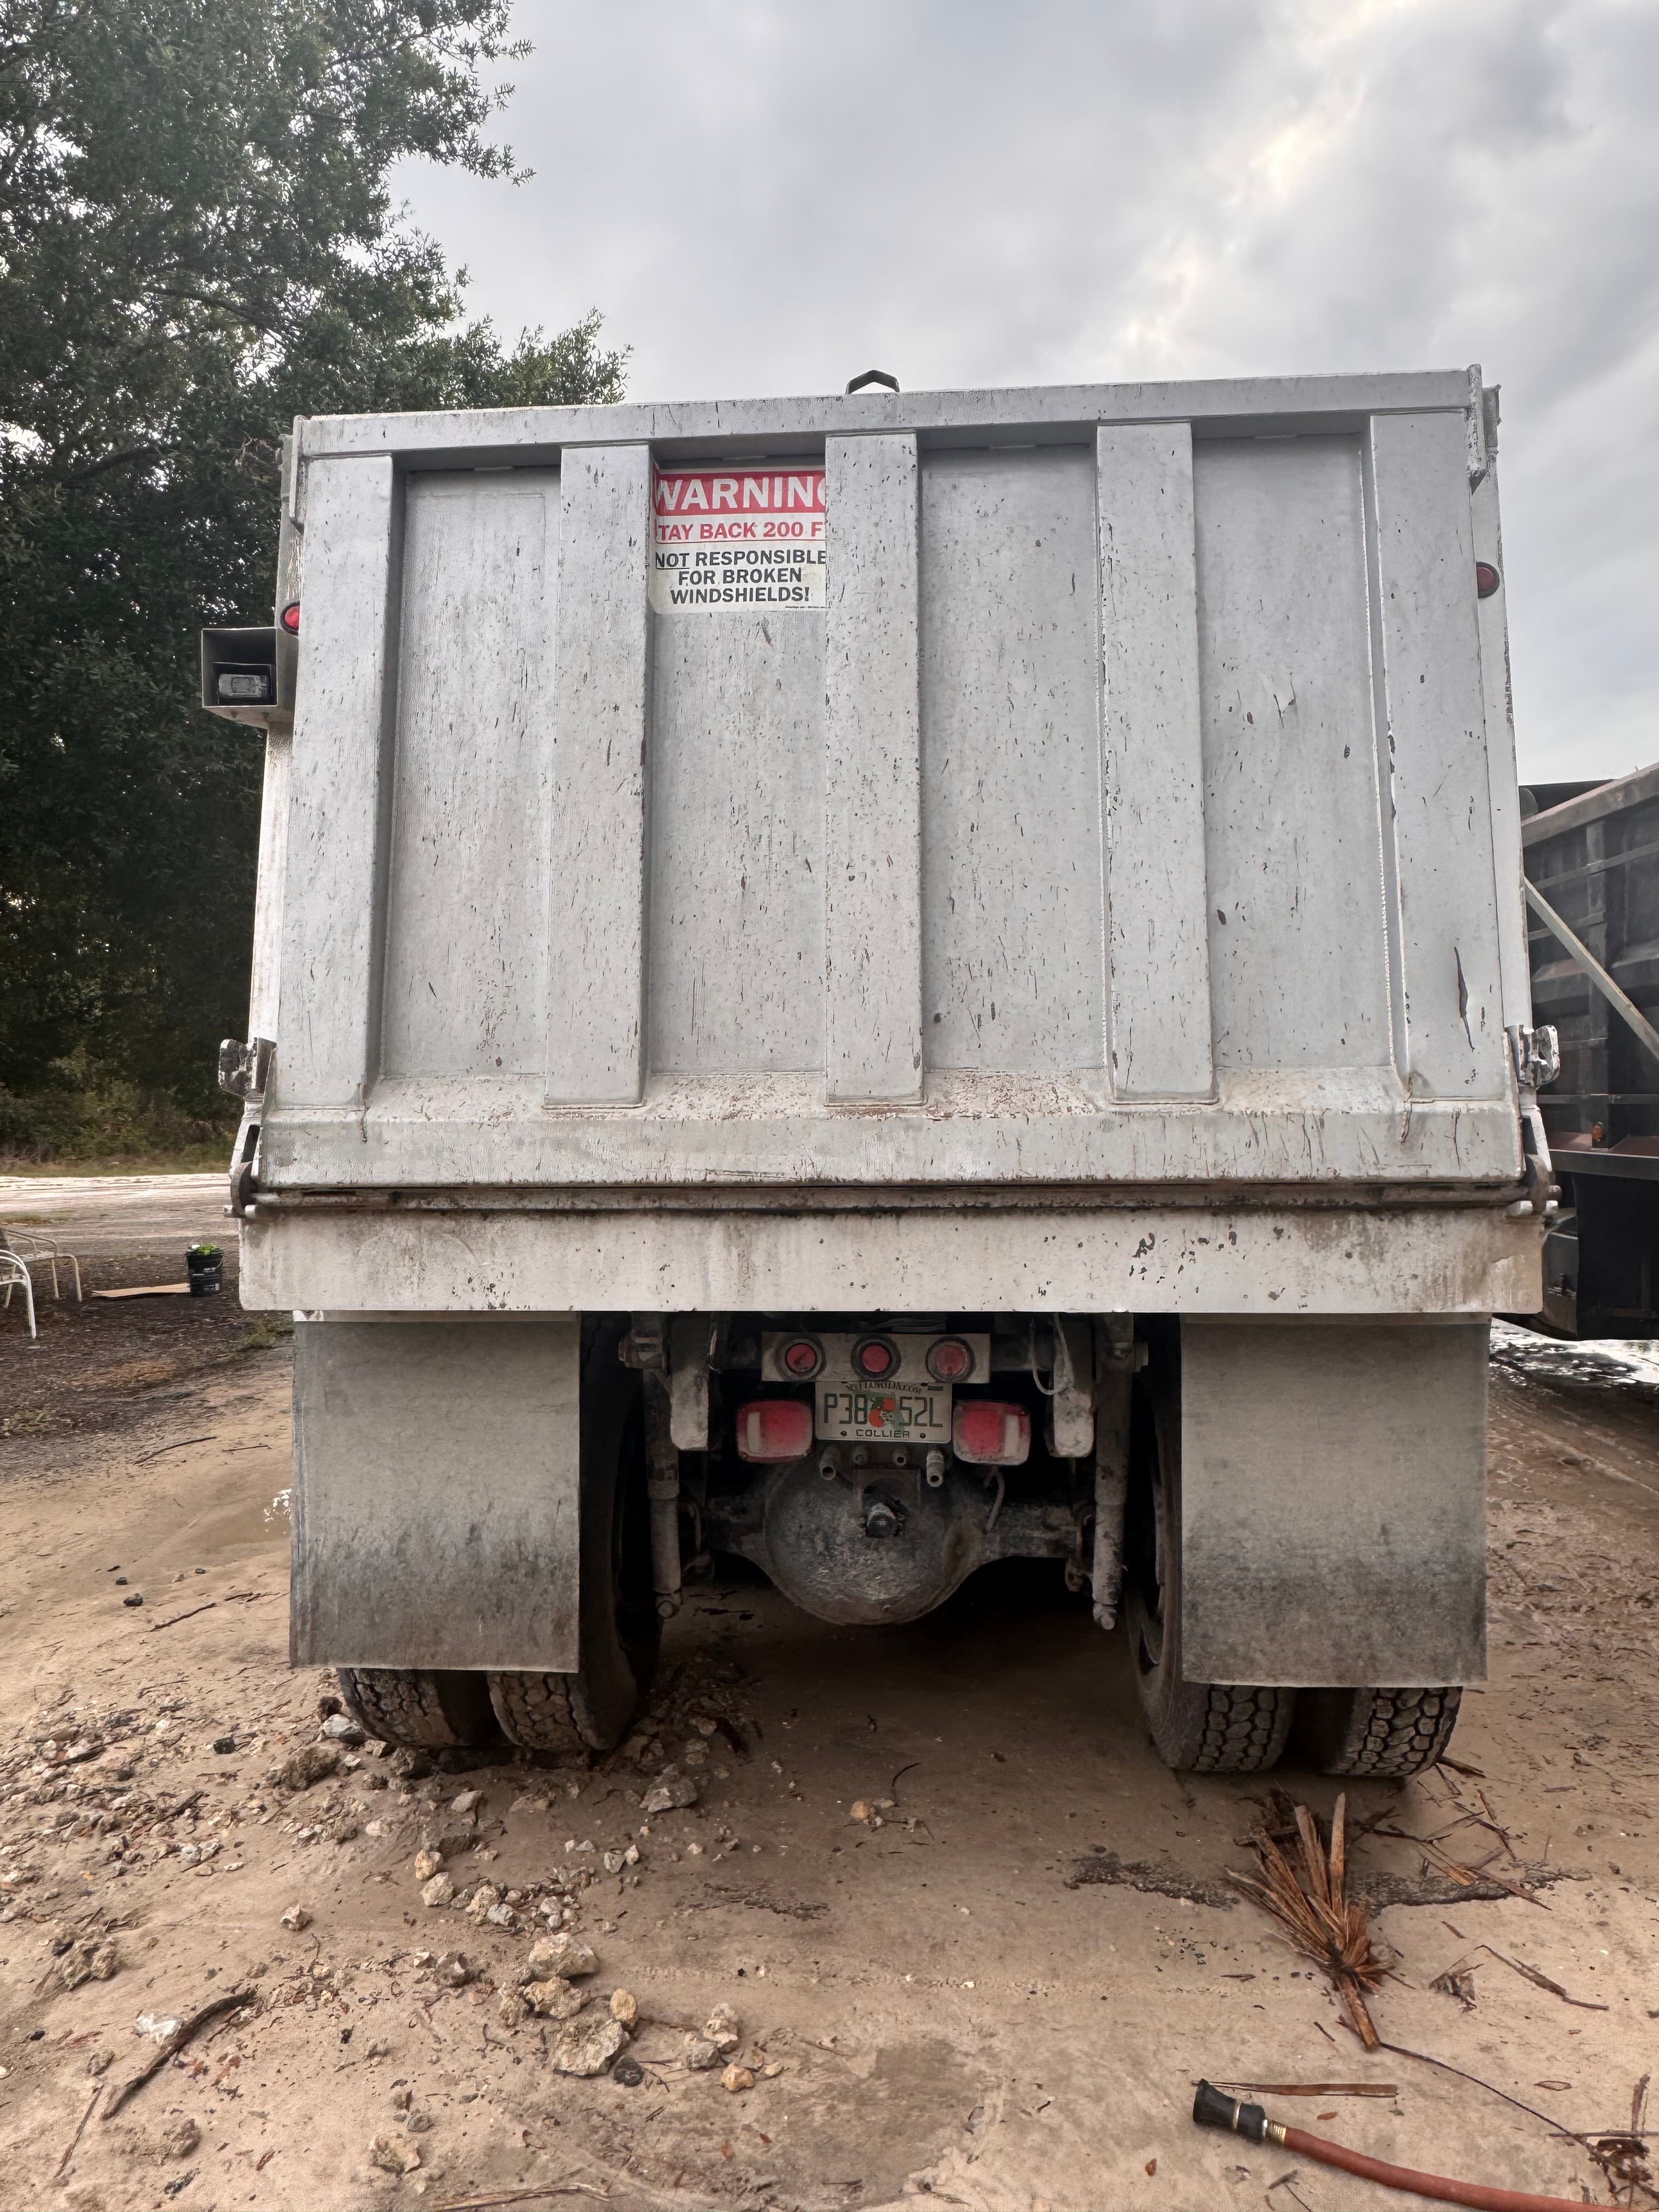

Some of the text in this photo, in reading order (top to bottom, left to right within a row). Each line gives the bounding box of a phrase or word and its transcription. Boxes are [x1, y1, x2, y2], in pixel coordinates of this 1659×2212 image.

[656, 521, 824, 541] TAY BACK 200 F
[655, 549, 826, 568] NOT RESPONSIBLE
[678, 567, 802, 585] FOR BROKEN
[670, 586, 810, 604] WINDSHIELDS!
[823, 1393, 943, 1428] P38 52L
[856, 1429, 910, 1438] COLLIER
